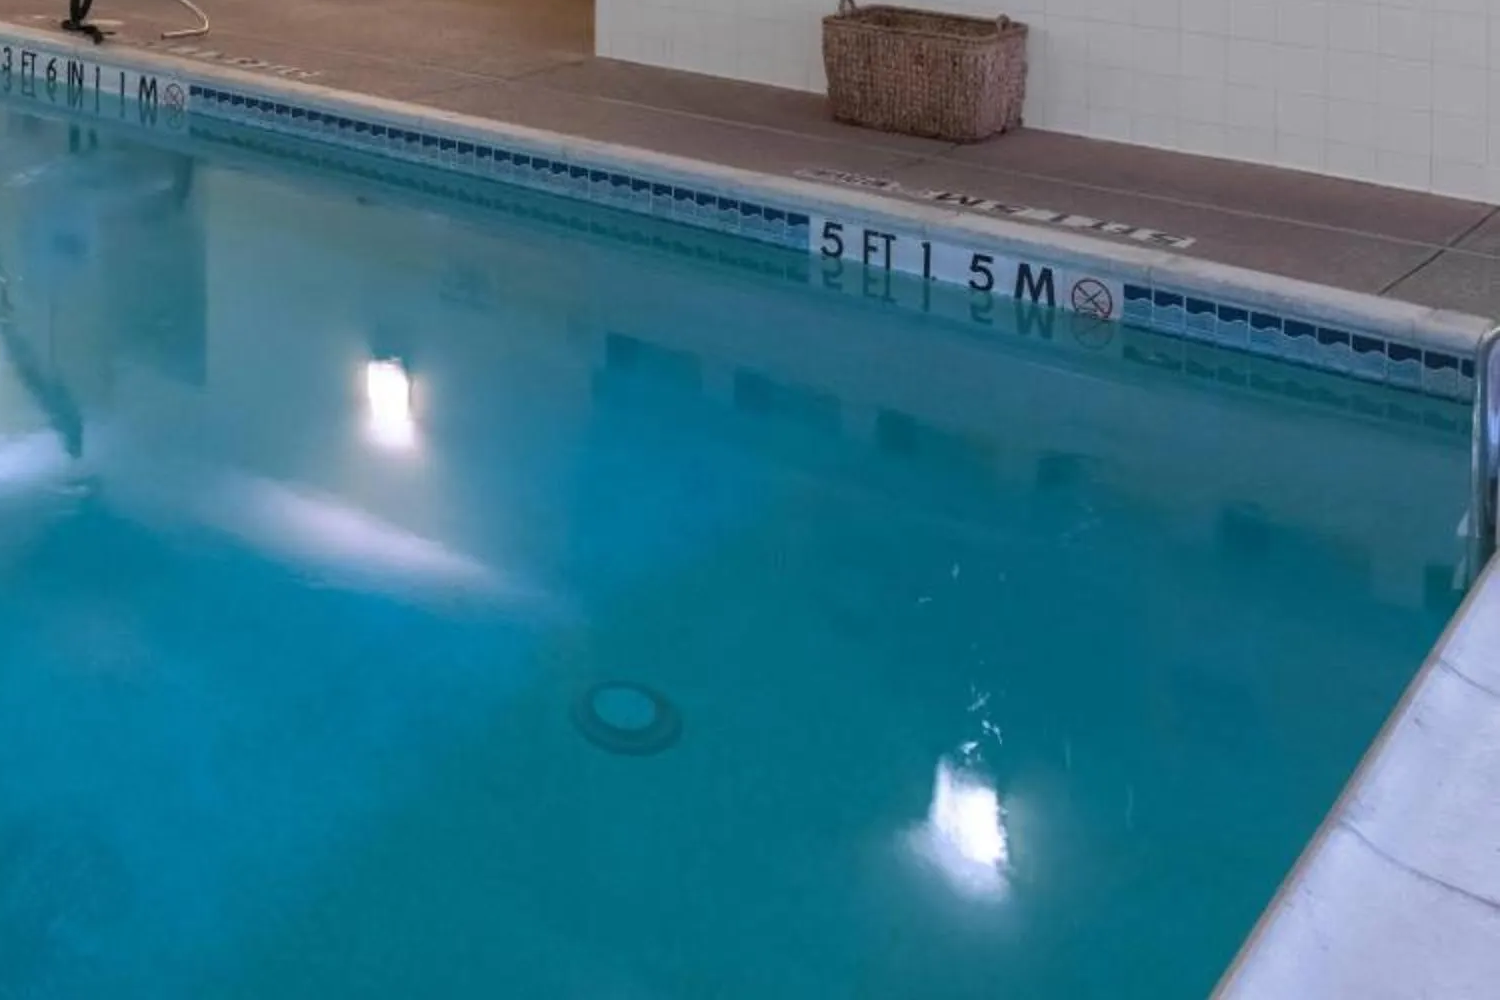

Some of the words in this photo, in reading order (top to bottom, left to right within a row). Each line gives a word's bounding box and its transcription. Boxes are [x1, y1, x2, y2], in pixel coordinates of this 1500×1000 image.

[2, 47, 11, 71] 3
[21, 50, 37, 72] FT
[46, 57, 57, 81] 6
[67, 60, 84, 87] IN
[139, 75, 158, 103] M
[821, 221, 844, 259] 5
[862, 229, 897, 271] FT
[1014, 263, 1055, 307] M
